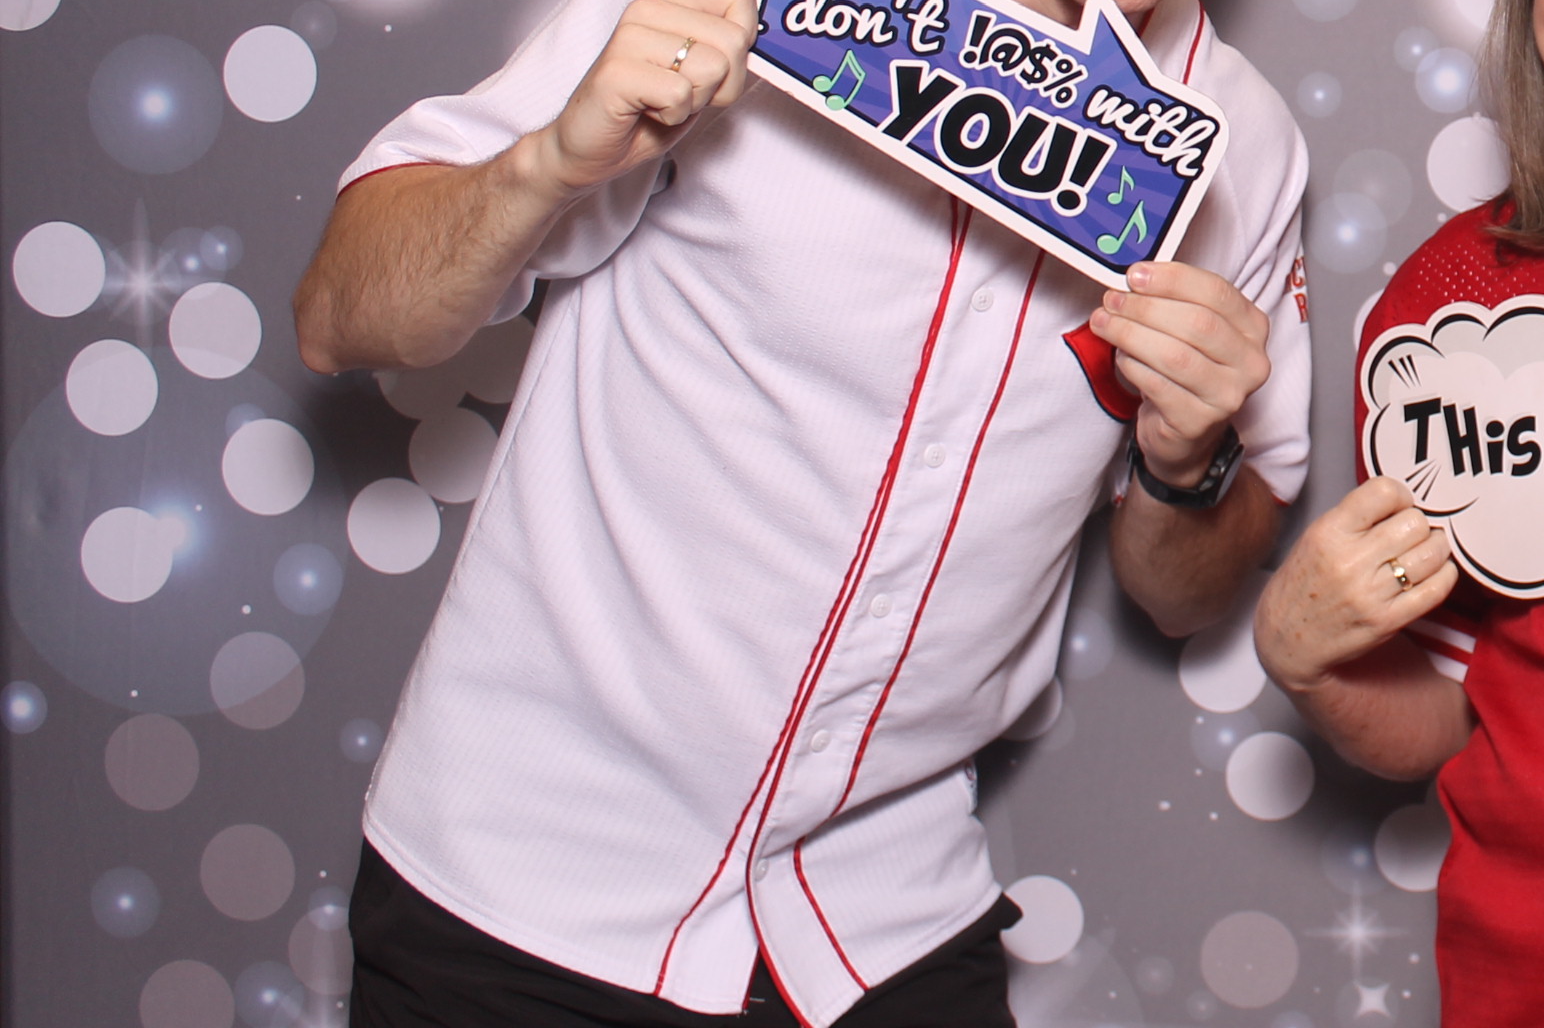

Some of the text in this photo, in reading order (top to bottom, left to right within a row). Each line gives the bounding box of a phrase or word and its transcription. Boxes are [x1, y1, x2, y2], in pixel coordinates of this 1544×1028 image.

[879, 62, 1114, 213] YOU!
[961, 12, 1086, 106] !@$%
[1083, 85, 1220, 179] with
